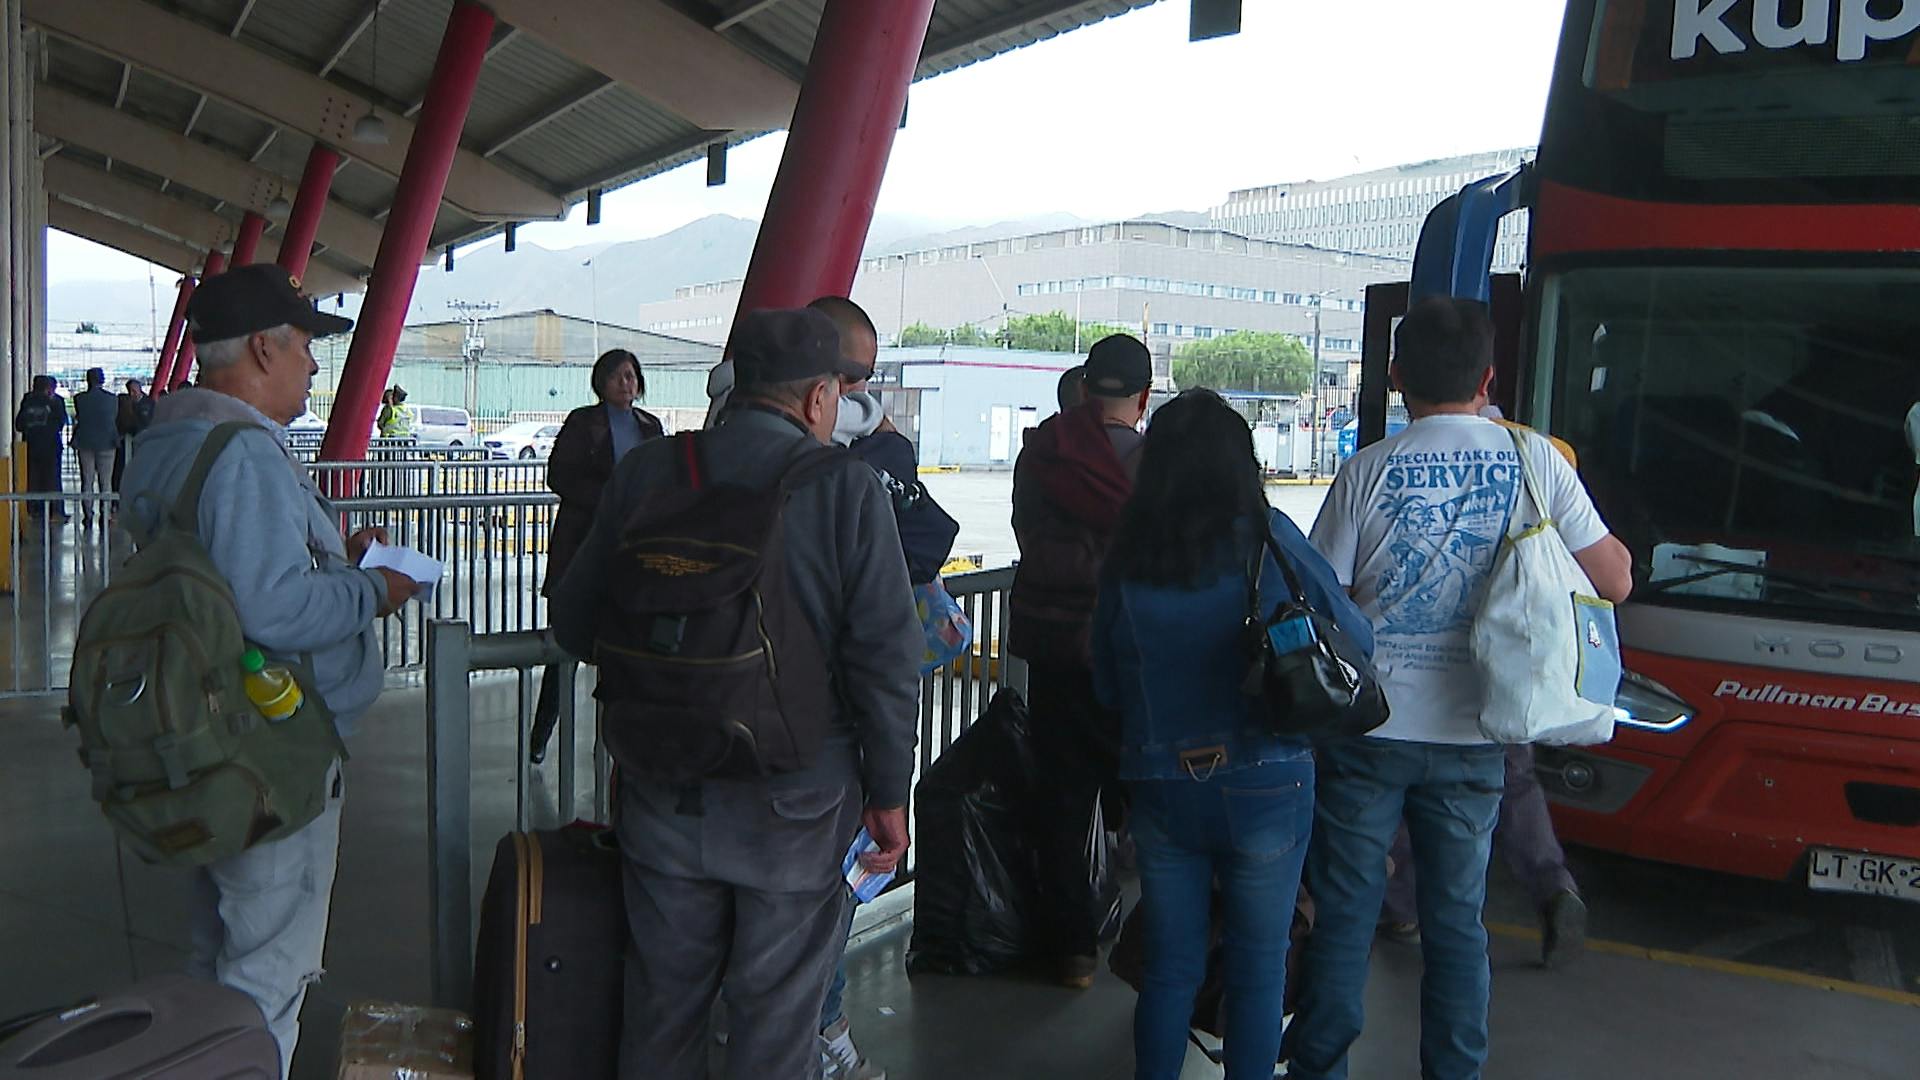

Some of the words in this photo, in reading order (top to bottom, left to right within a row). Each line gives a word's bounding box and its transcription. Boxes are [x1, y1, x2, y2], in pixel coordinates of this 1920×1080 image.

[1387, 452, 1448, 465] SPECIAL
[1452, 450, 1492, 462] TAKE
[1496, 450, 1519, 462] OU
[1713, 680, 1856, 711] Pullman
